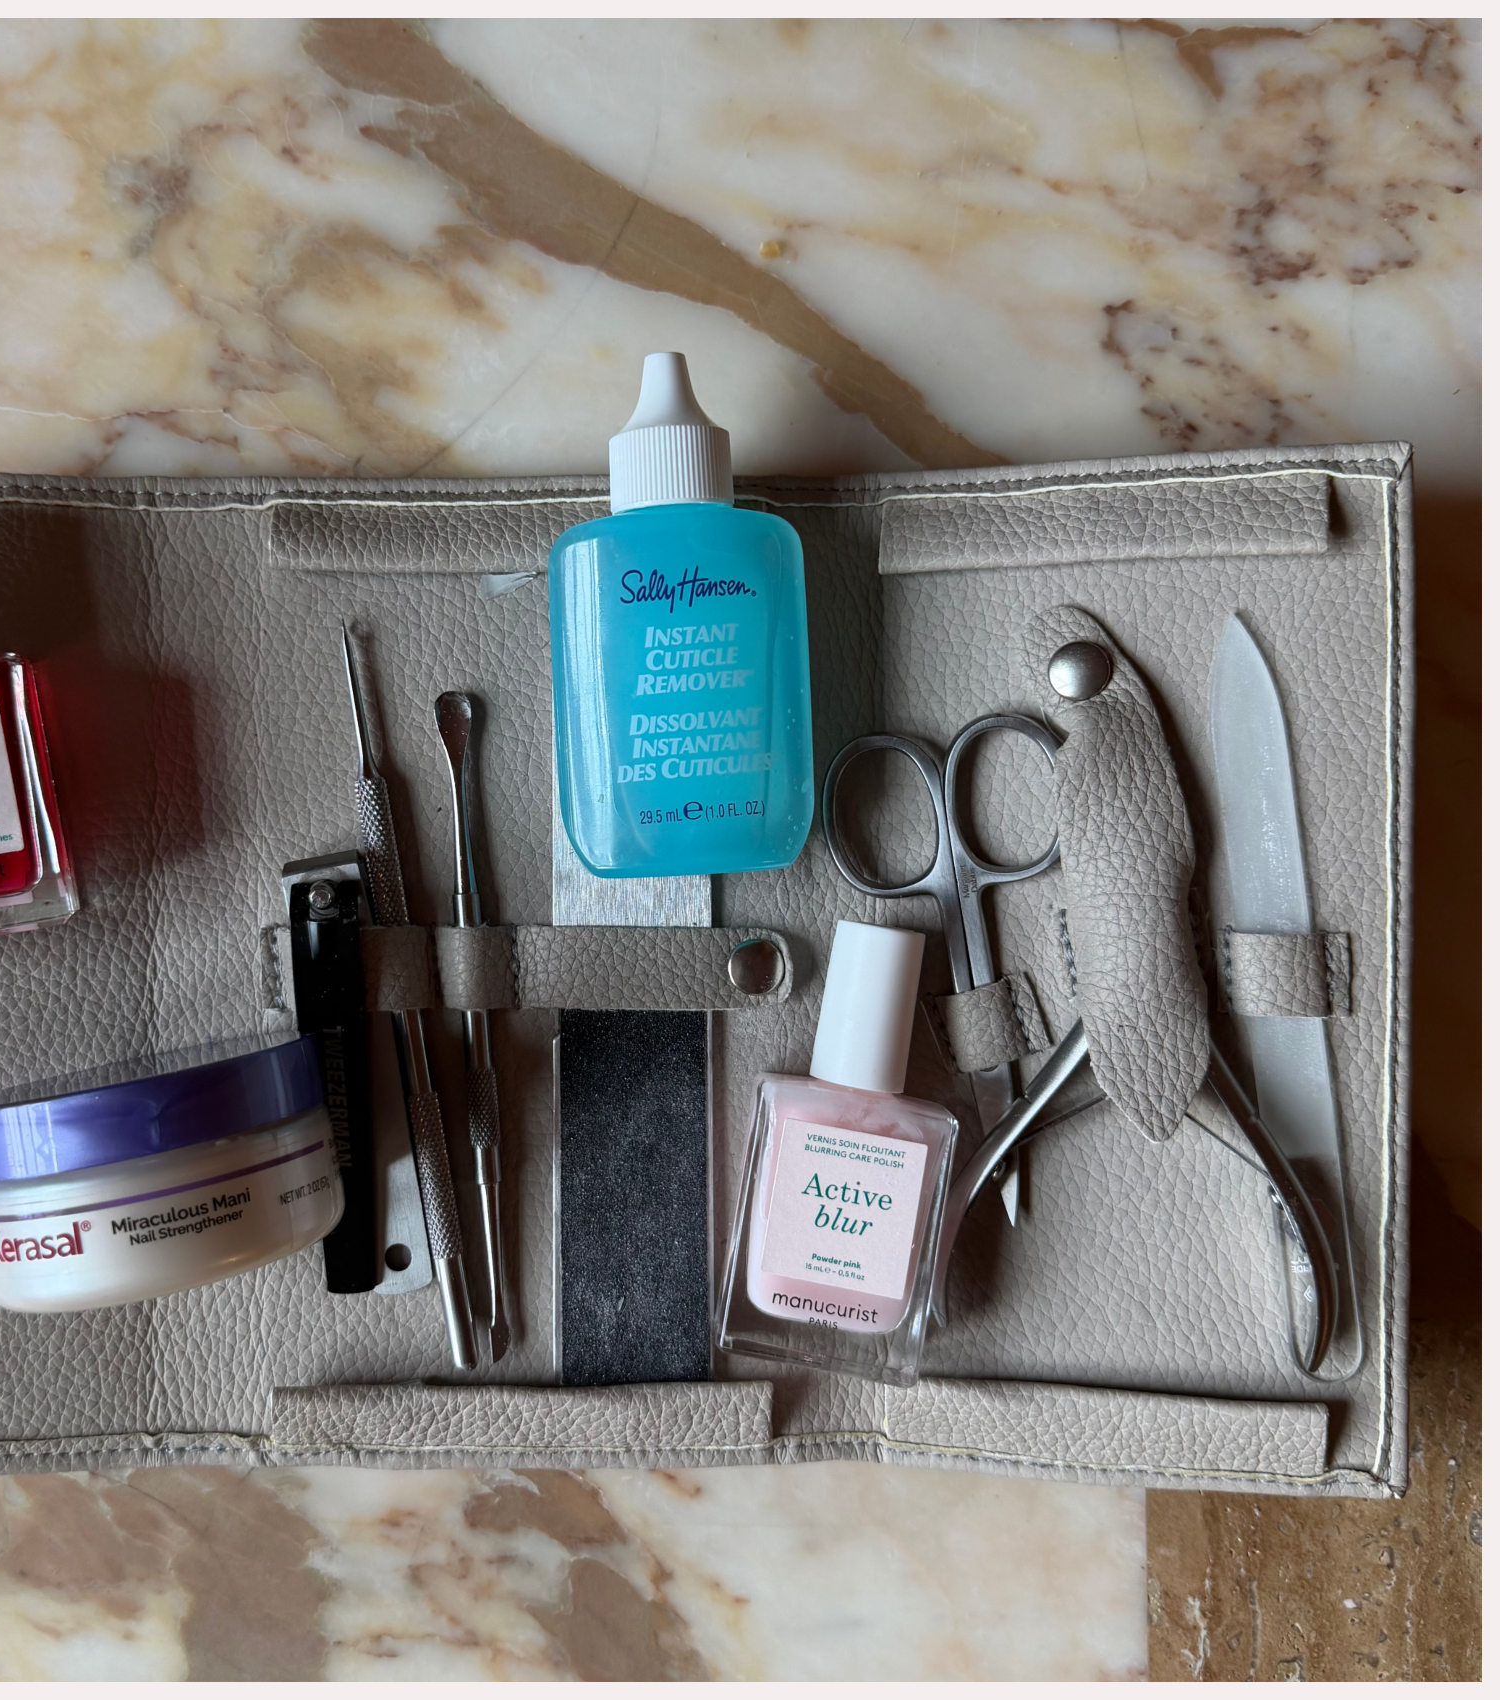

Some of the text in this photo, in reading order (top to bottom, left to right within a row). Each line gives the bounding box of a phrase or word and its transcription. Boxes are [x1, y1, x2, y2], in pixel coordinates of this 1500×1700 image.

[620, 569, 675, 613] Sally
[645, 624, 739, 648] INSTANT
[646, 647, 739, 671] CUTICLE
[630, 708, 761, 736] DISSOLVANT
[617, 752, 772, 784] DES CUTICULES
[640, 810, 662, 824] 29.5
[666, 808, 683, 822] mL
[705, 804, 725, 822] (1.0
[728, 803, 743, 817] FL.
[746, 801, 765, 817] OZ.)
[323, 1026, 352, 1167] TWEEZERMAN
[805, 1144, 904, 1169] BLURRING CARE POLISH
[807, 1134, 906, 1159] VERNIS SOIN FLOUTANT
[280, 1190, 294, 1205] NET
[801, 1173, 893, 1211] Active
[112, 1188, 251, 1235] Miraculous Mani
[815, 1204, 873, 1236] blur
[130, 1210, 244, 1246] Nail Strengthener
[812, 1253, 861, 1269] Powder pink
[772, 1293, 878, 1324] manucurist
[809, 1317, 838, 1329] PARIS
